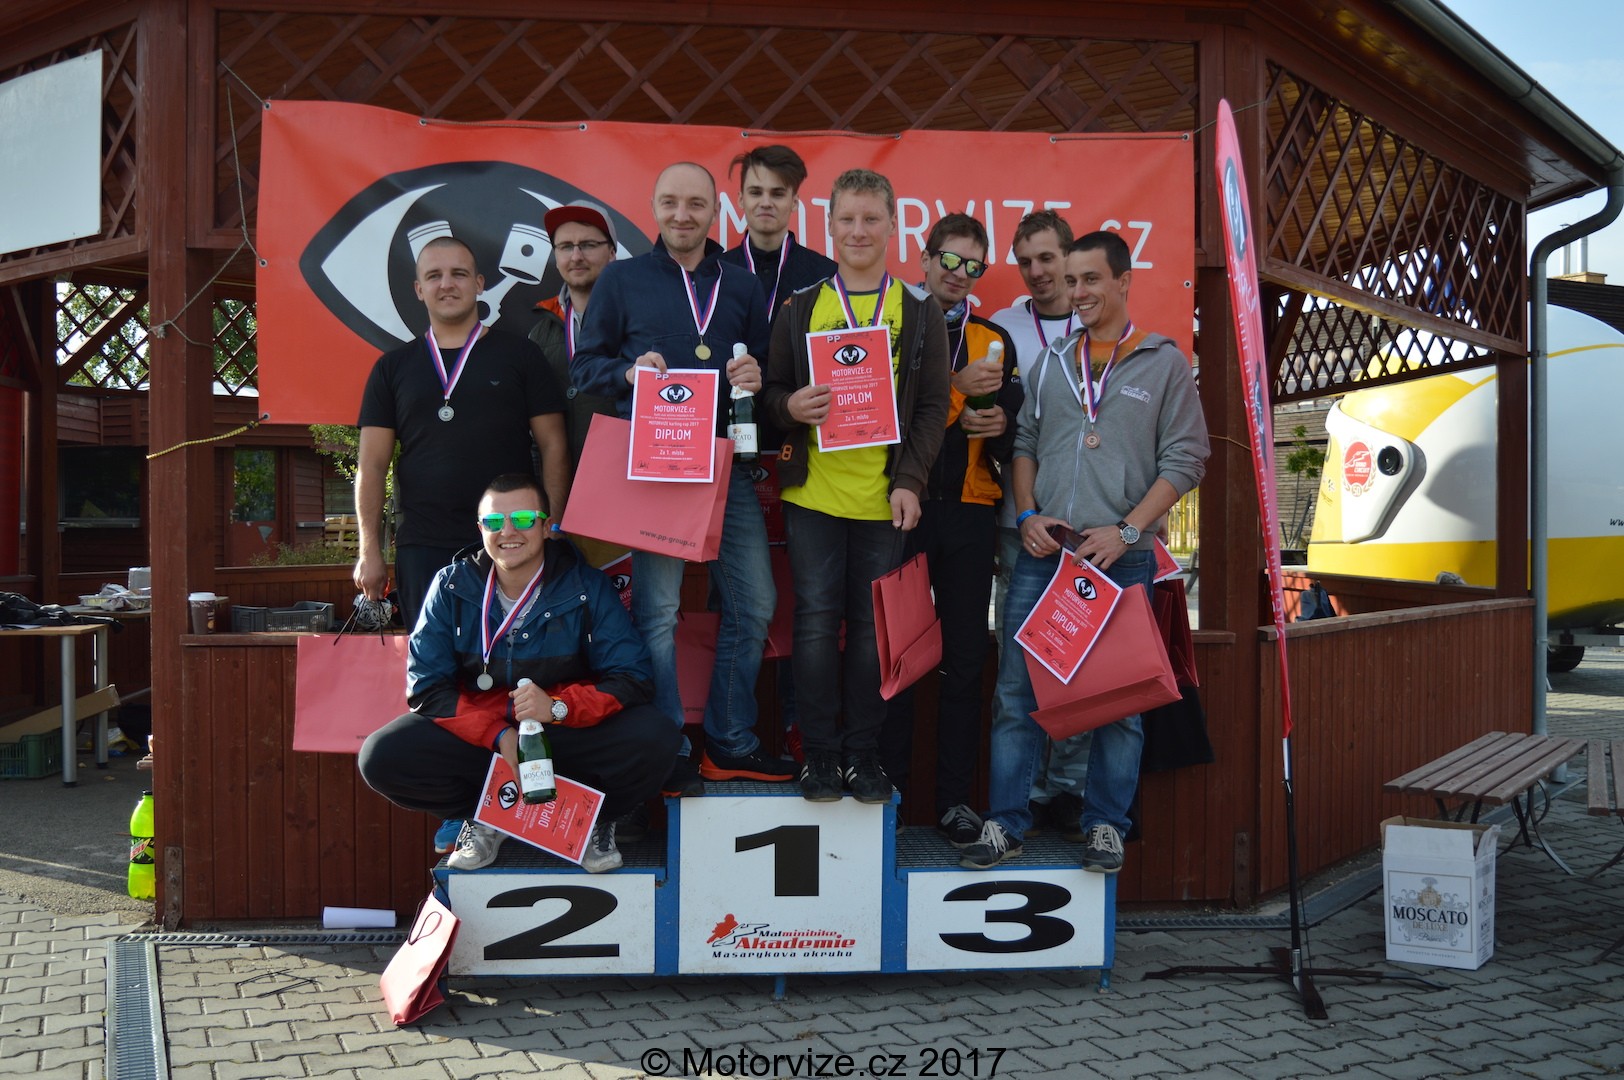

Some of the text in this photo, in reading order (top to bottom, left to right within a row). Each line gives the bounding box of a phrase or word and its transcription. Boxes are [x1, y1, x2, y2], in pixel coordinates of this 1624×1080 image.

[831, 367, 873, 377] MOTORVIZE.cz
[837, 392, 873, 406] DIPLOM
[653, 405, 696, 413] MOTORVIZE.cz
[655, 428, 691, 440] DIPLOM
[640, 529, 697, 548] www.pp-group.cz
[1064, 588, 1092, 615] MOTORVIZE.cz
[1051, 609, 1079, 636] DIPLOM
[523, 769, 551, 780] MOSCATO
[735, 825, 820, 897] 1
[484, 885, 620, 960] 2
[939, 880, 1075, 954] 3
[1392, 905, 1468, 926] MOSCATO
[1425, 922, 1448, 932] LUXE
[734, 934, 856, 949] Akademie
[712, 950, 852, 959] Masarykova okruhu
